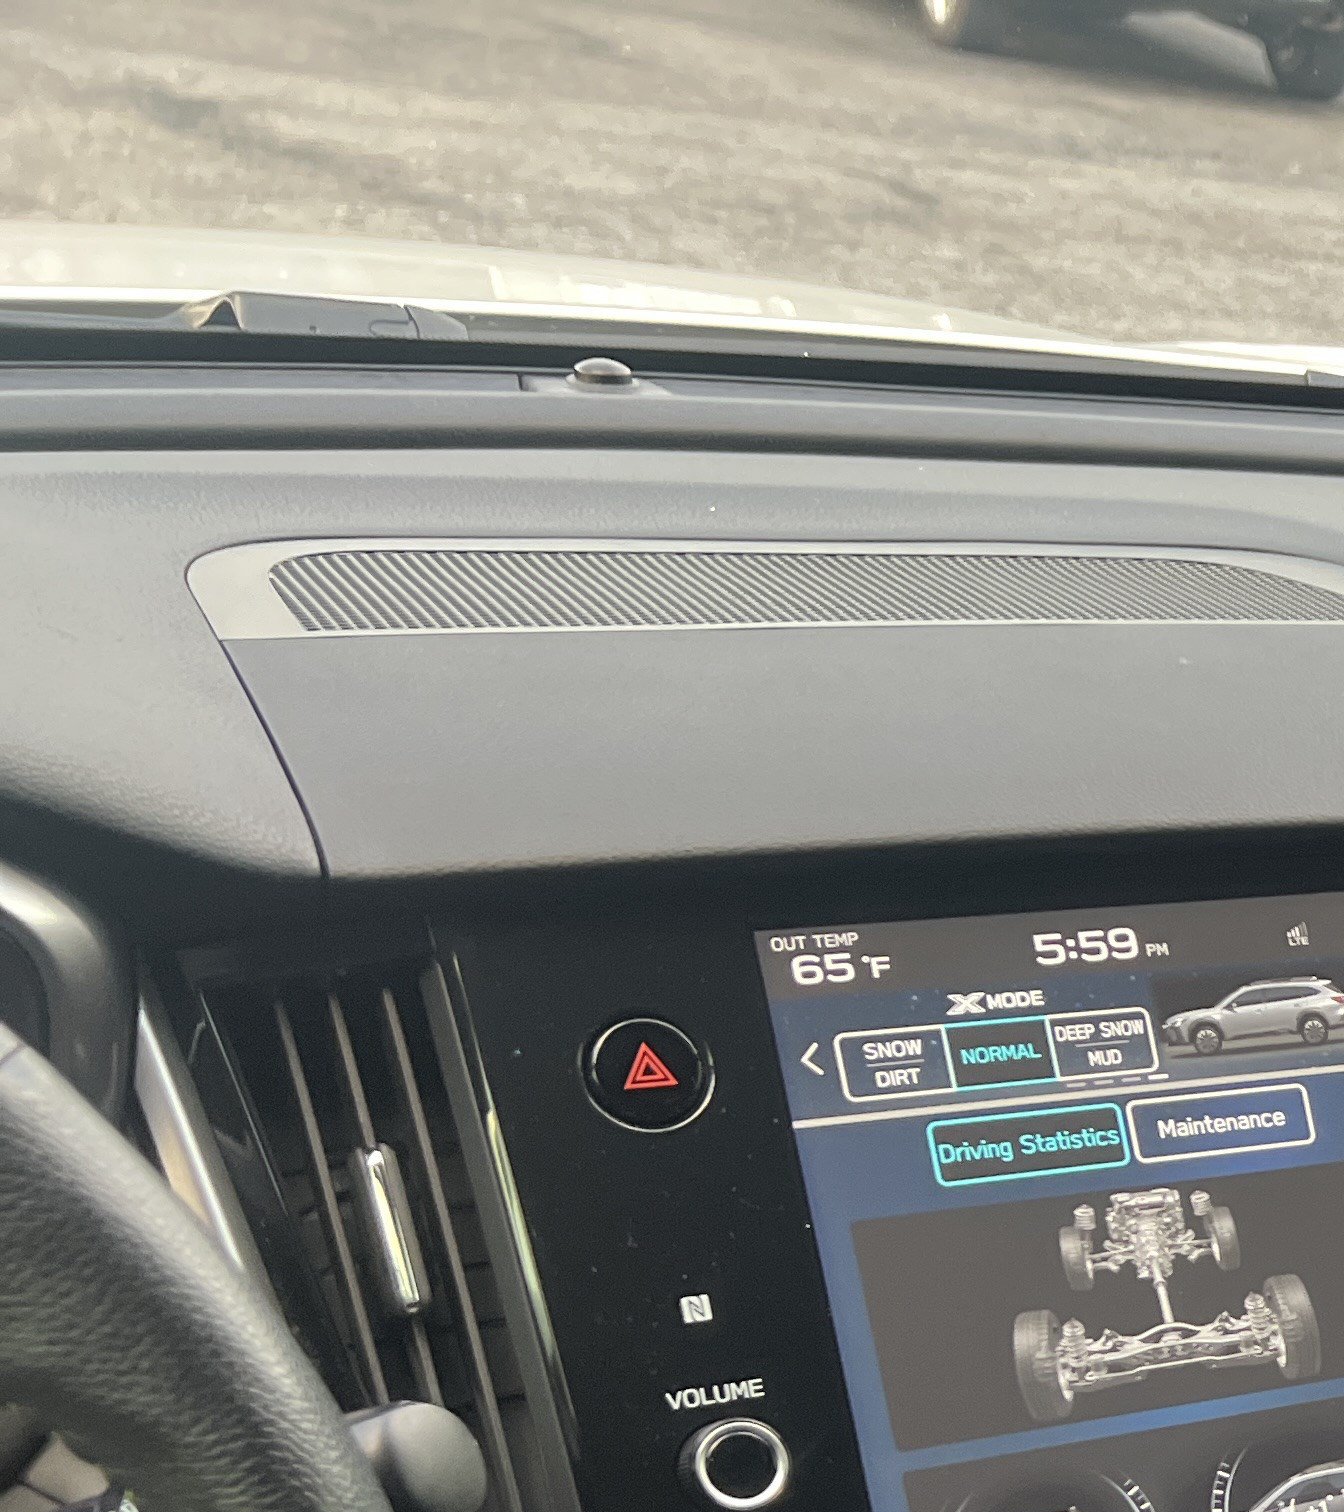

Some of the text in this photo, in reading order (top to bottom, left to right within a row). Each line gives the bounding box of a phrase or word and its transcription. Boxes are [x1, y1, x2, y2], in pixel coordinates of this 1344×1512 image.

[769, 932, 859, 953] OUT TEMP
[1032, 927, 1170, 966] 5:59 PM
[790, 953, 856, 986] 65
[1054, 1018, 1144, 1042] DEEP SNOW
[862, 1038, 923, 1061] SNOW
[960, 1043, 1043, 1066] NORMAL
[1087, 1048, 1123, 1068] MUD
[875, 1067, 921, 1089] DIRT
[1157, 1110, 1287, 1140] Maintenance
[938, 1127, 1121, 1166] Driving Statistics
[664, 1377, 766, 1411] VOLUME
